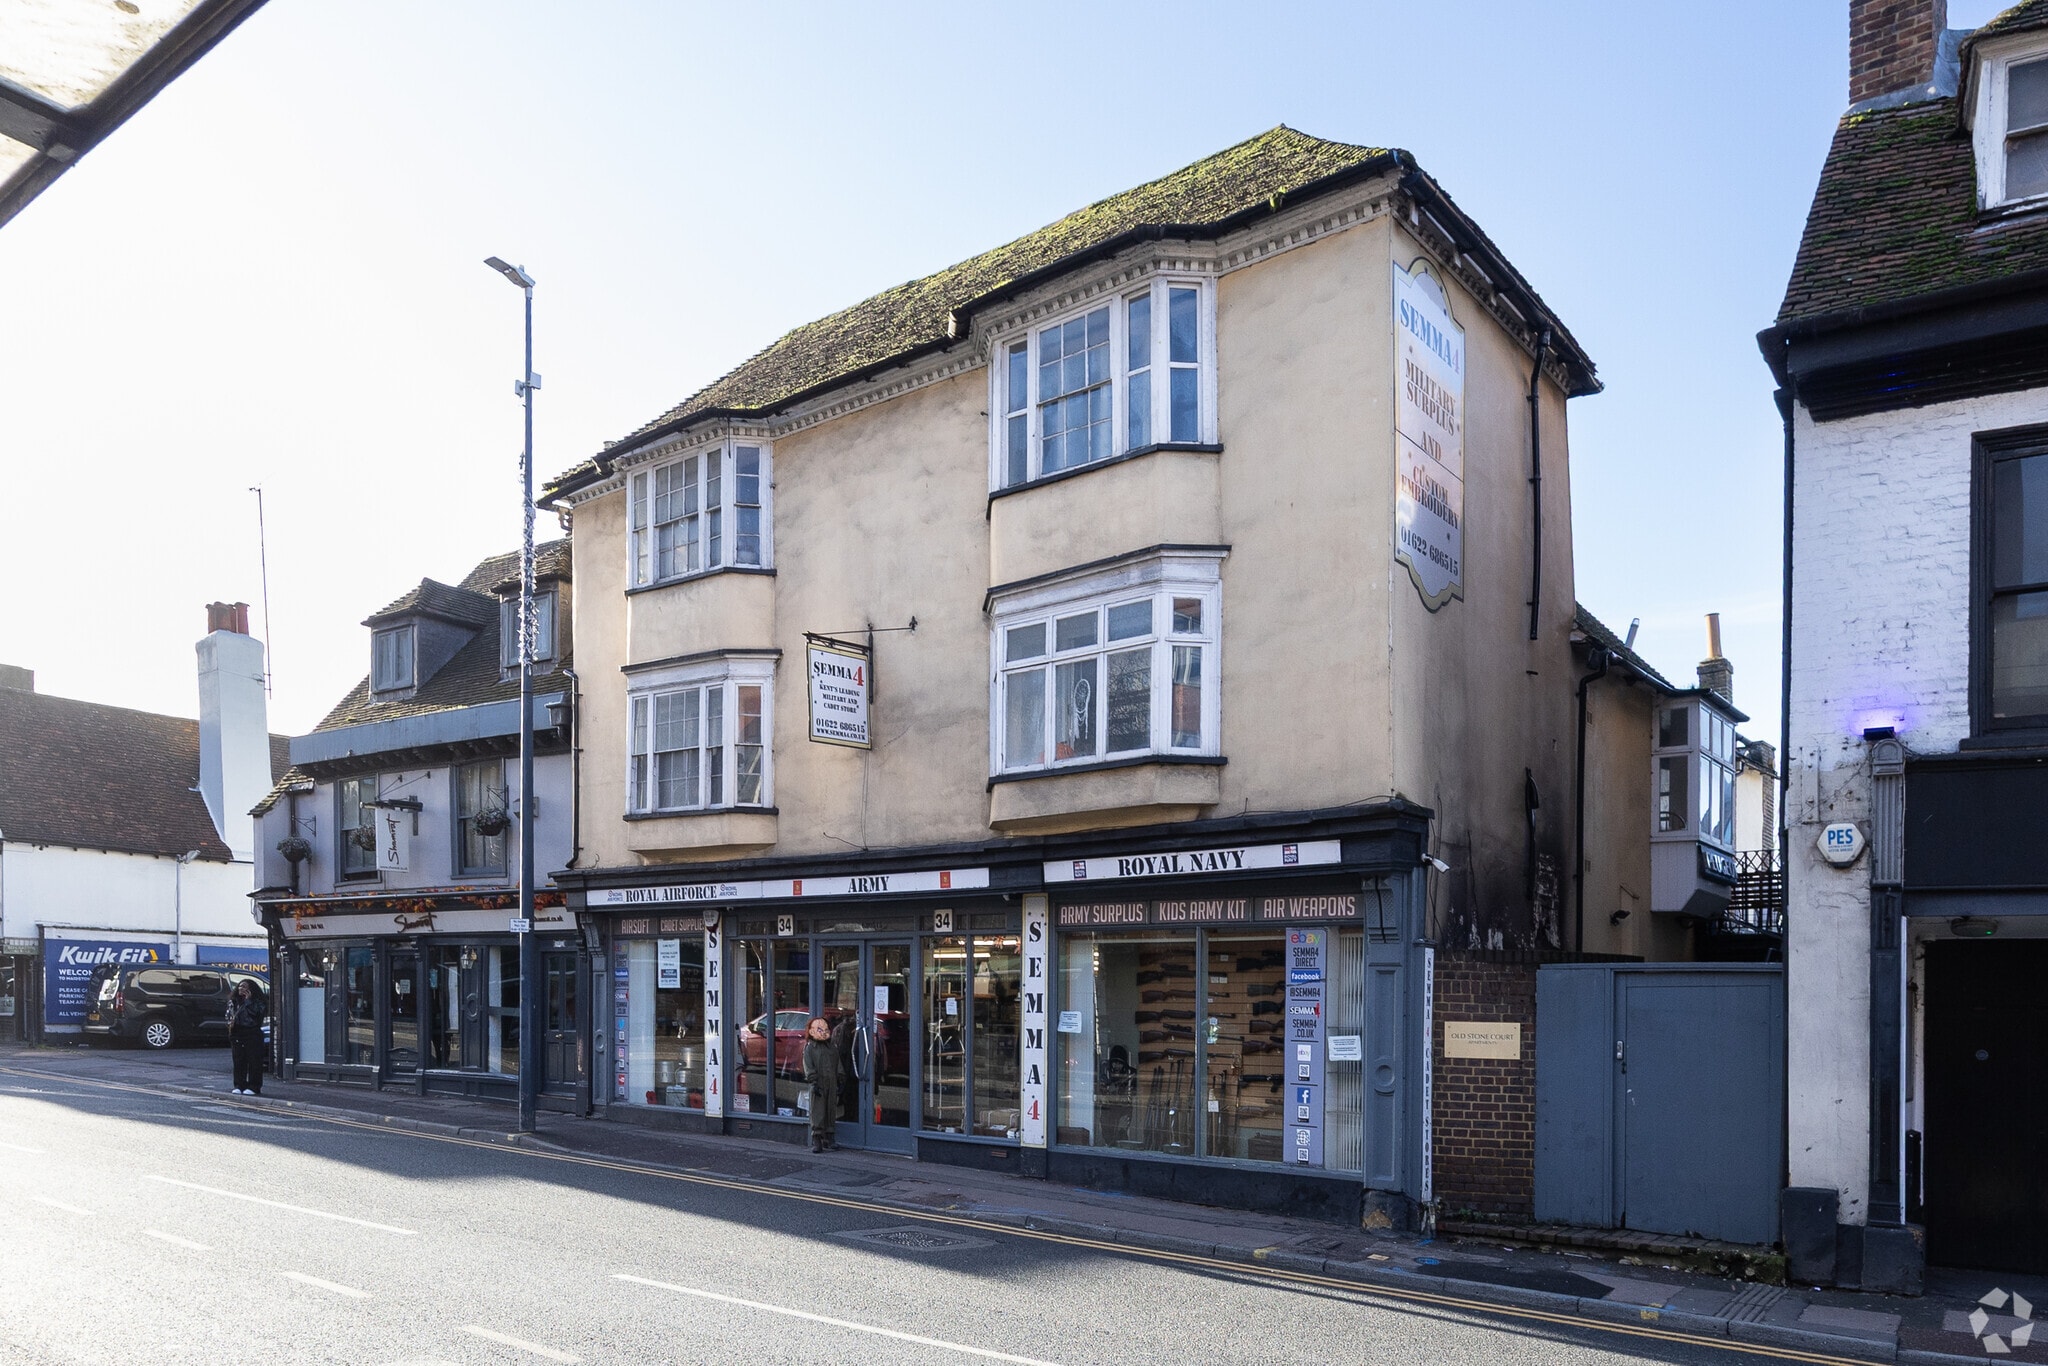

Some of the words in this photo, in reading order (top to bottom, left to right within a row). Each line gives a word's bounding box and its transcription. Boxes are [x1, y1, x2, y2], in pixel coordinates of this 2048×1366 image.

[1400, 298, 1460, 374] SEMMA4
[1405, 358, 1456, 417] MILITARY
[1407, 381, 1455, 436] SURPLUS
[1421, 431, 1442, 461] AND
[1413, 465, 1449, 506] CUSTOM
[1401, 474, 1459, 530] EMBROIDERY
[1400, 526, 1427, 556] 01622
[1429, 544, 1459, 576] 686515
[814, 661, 864, 686] SEMMA4
[819, 684, 838, 693] KENT'S
[838, 687, 860, 697] LEADING
[823, 693, 846, 703] MILITARY
[847, 697, 858, 705] AND
[823, 702, 840, 711] CADET
[841, 705, 857, 714] STORE
[816, 717, 838, 729] 01622
[839, 722, 865, 733] 686515
[816, 727, 866, 740] WWW.SEMMA4.CO.UK
[1828, 829, 1853, 845] PES
[1118, 855, 1184, 877] ROYAL
[1190, 850, 1245, 870] NAVY
[848, 876, 890, 893] ARMY
[626, 889, 659, 903] ROYAL
[662, 885, 717, 901] AIRFORCE
[1060, 905, 1091, 924] ARMY
[1093, 903, 1143, 923] SURPLUS
[1159, 901, 1186, 921] KIDS
[1189, 901, 1224, 920] ARMY
[1227, 899, 1246, 919] KIT
[1263, 899, 1285, 918] AIR
[1288, 896, 1355, 917] WEAPONS
[621, 919, 650, 934] AIRSOFT
[660, 920, 678, 932] CADET
[779, 918, 791, 932] 34
[936, 913, 950, 928] 34
[1290, 930, 1321, 945] ebay
[58, 945, 118, 965] Kwik
[119, 948, 149, 963] Fit
[1292, 947, 1319, 957] SEMMA4
[1295, 958, 1316, 967] DIRECT
[1291, 972, 1320, 980] facebook
[1290, 987, 1321, 997] @SEMMA4
[1290, 1002, 1321, 1018] SEMMA4
[1292, 1019, 1317, 1028] SEMMA4
[1294, 1029, 1314, 1038] .CO.UK
